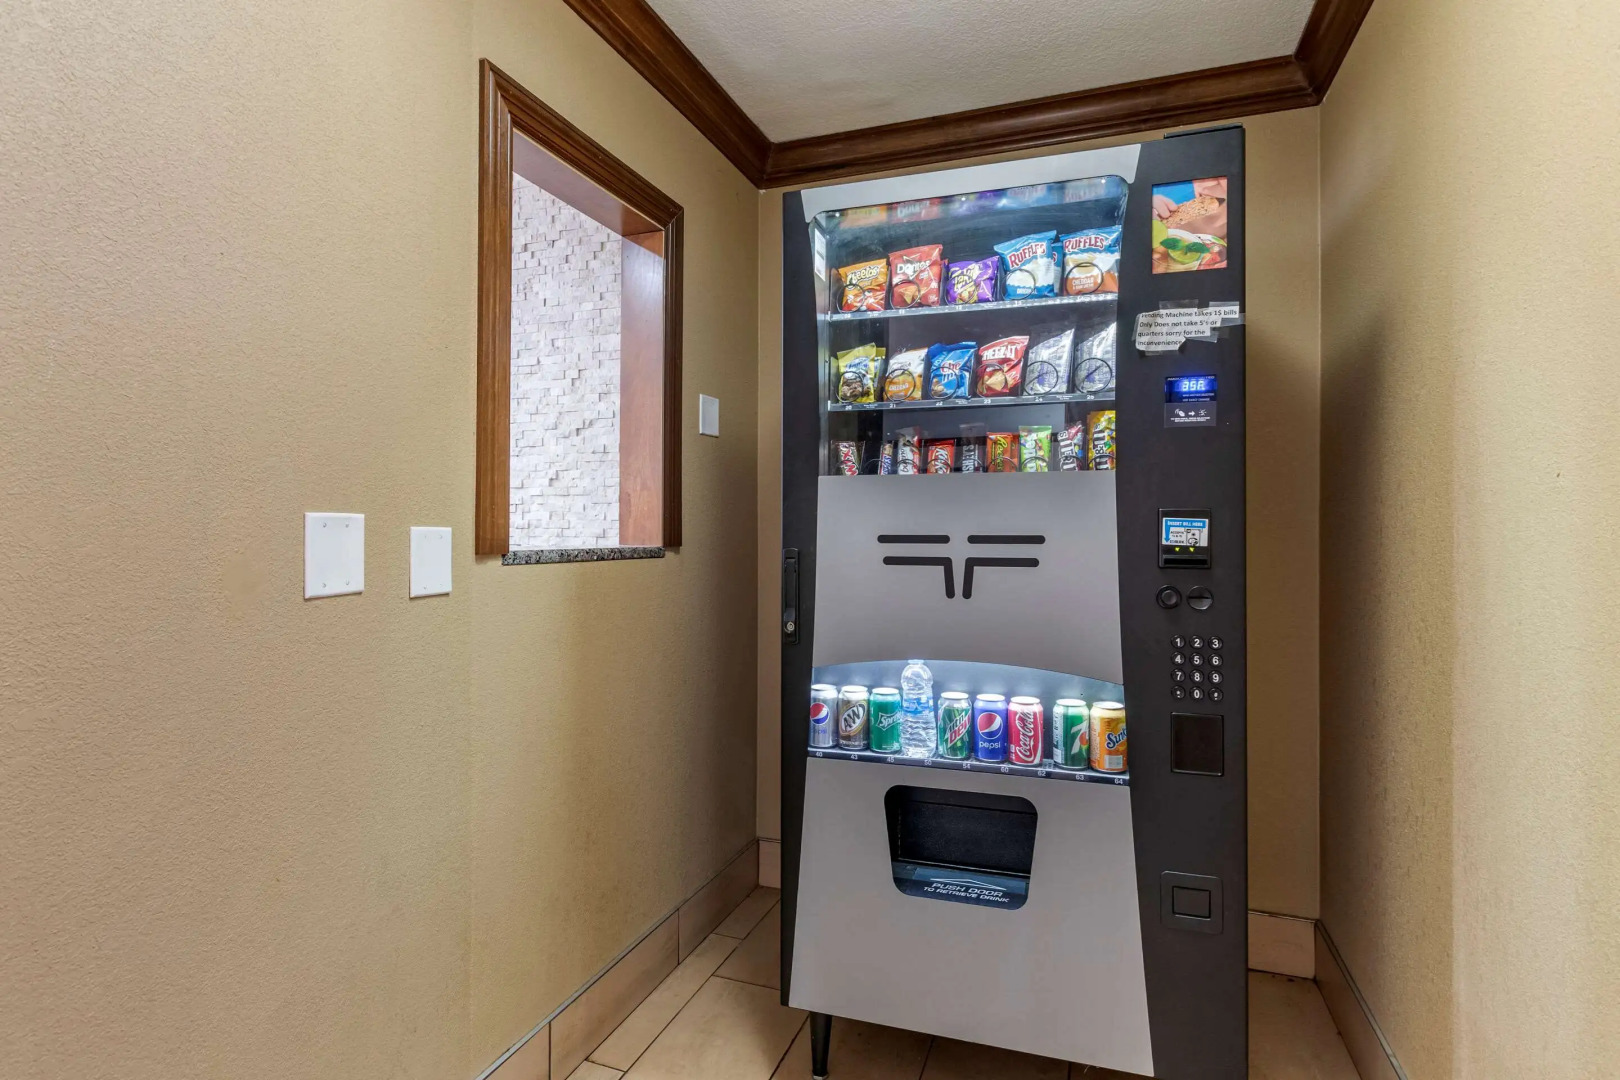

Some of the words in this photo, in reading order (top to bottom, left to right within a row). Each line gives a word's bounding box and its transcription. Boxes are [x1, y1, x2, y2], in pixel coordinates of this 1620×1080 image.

[1064, 236, 1105, 252] RUFFLES
[1008, 243, 1046, 269] RUFFLES
[1175, 637, 1181, 647] 1
[1194, 638, 1200, 647] 2
[1212, 639, 1219, 648] 3
[1175, 654, 1181, 664] 4
[1193, 655, 1200, 665] 5
[1212, 656, 1219, 665] 6
[1176, 671, 1182, 681] 7
[1194, 672, 1200, 682] 8
[1212, 673, 1219, 682] 9
[1193, 689, 1200, 699] 0
[979, 741, 1001, 750] pepsi
[931, 882, 965, 892] PUSH
[968, 888, 1003, 897] DOOR
[936, 888, 978, 899] RETRIEVE
[979, 894, 1010, 903] DRINK
